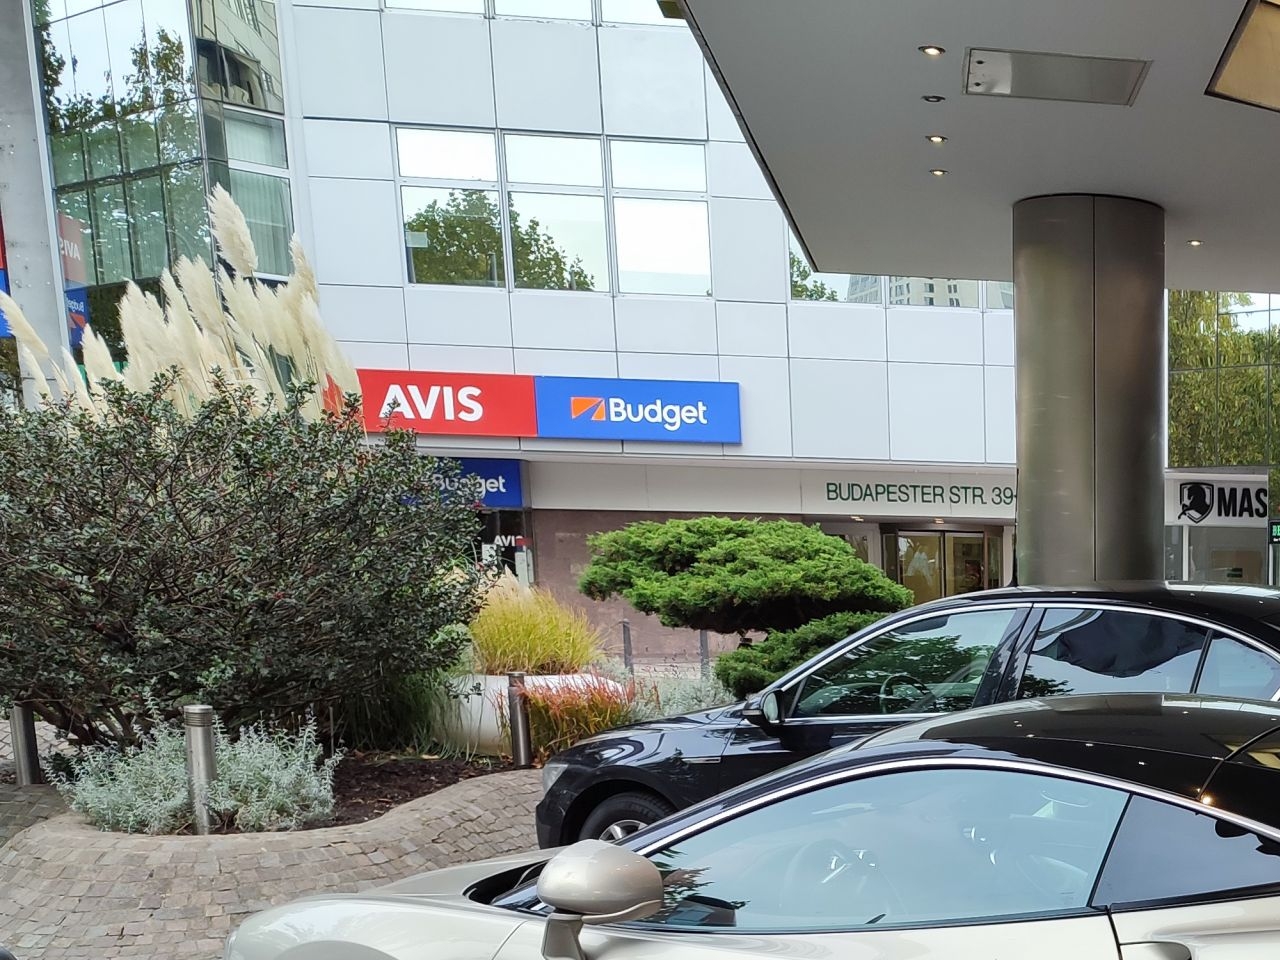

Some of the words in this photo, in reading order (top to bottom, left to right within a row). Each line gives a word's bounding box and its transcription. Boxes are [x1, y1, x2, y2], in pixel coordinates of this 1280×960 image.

[378, 383, 484, 422] AVIS
[609, 396, 708, 431] Budget
[826, 482, 945, 503] BUDAPESTER
